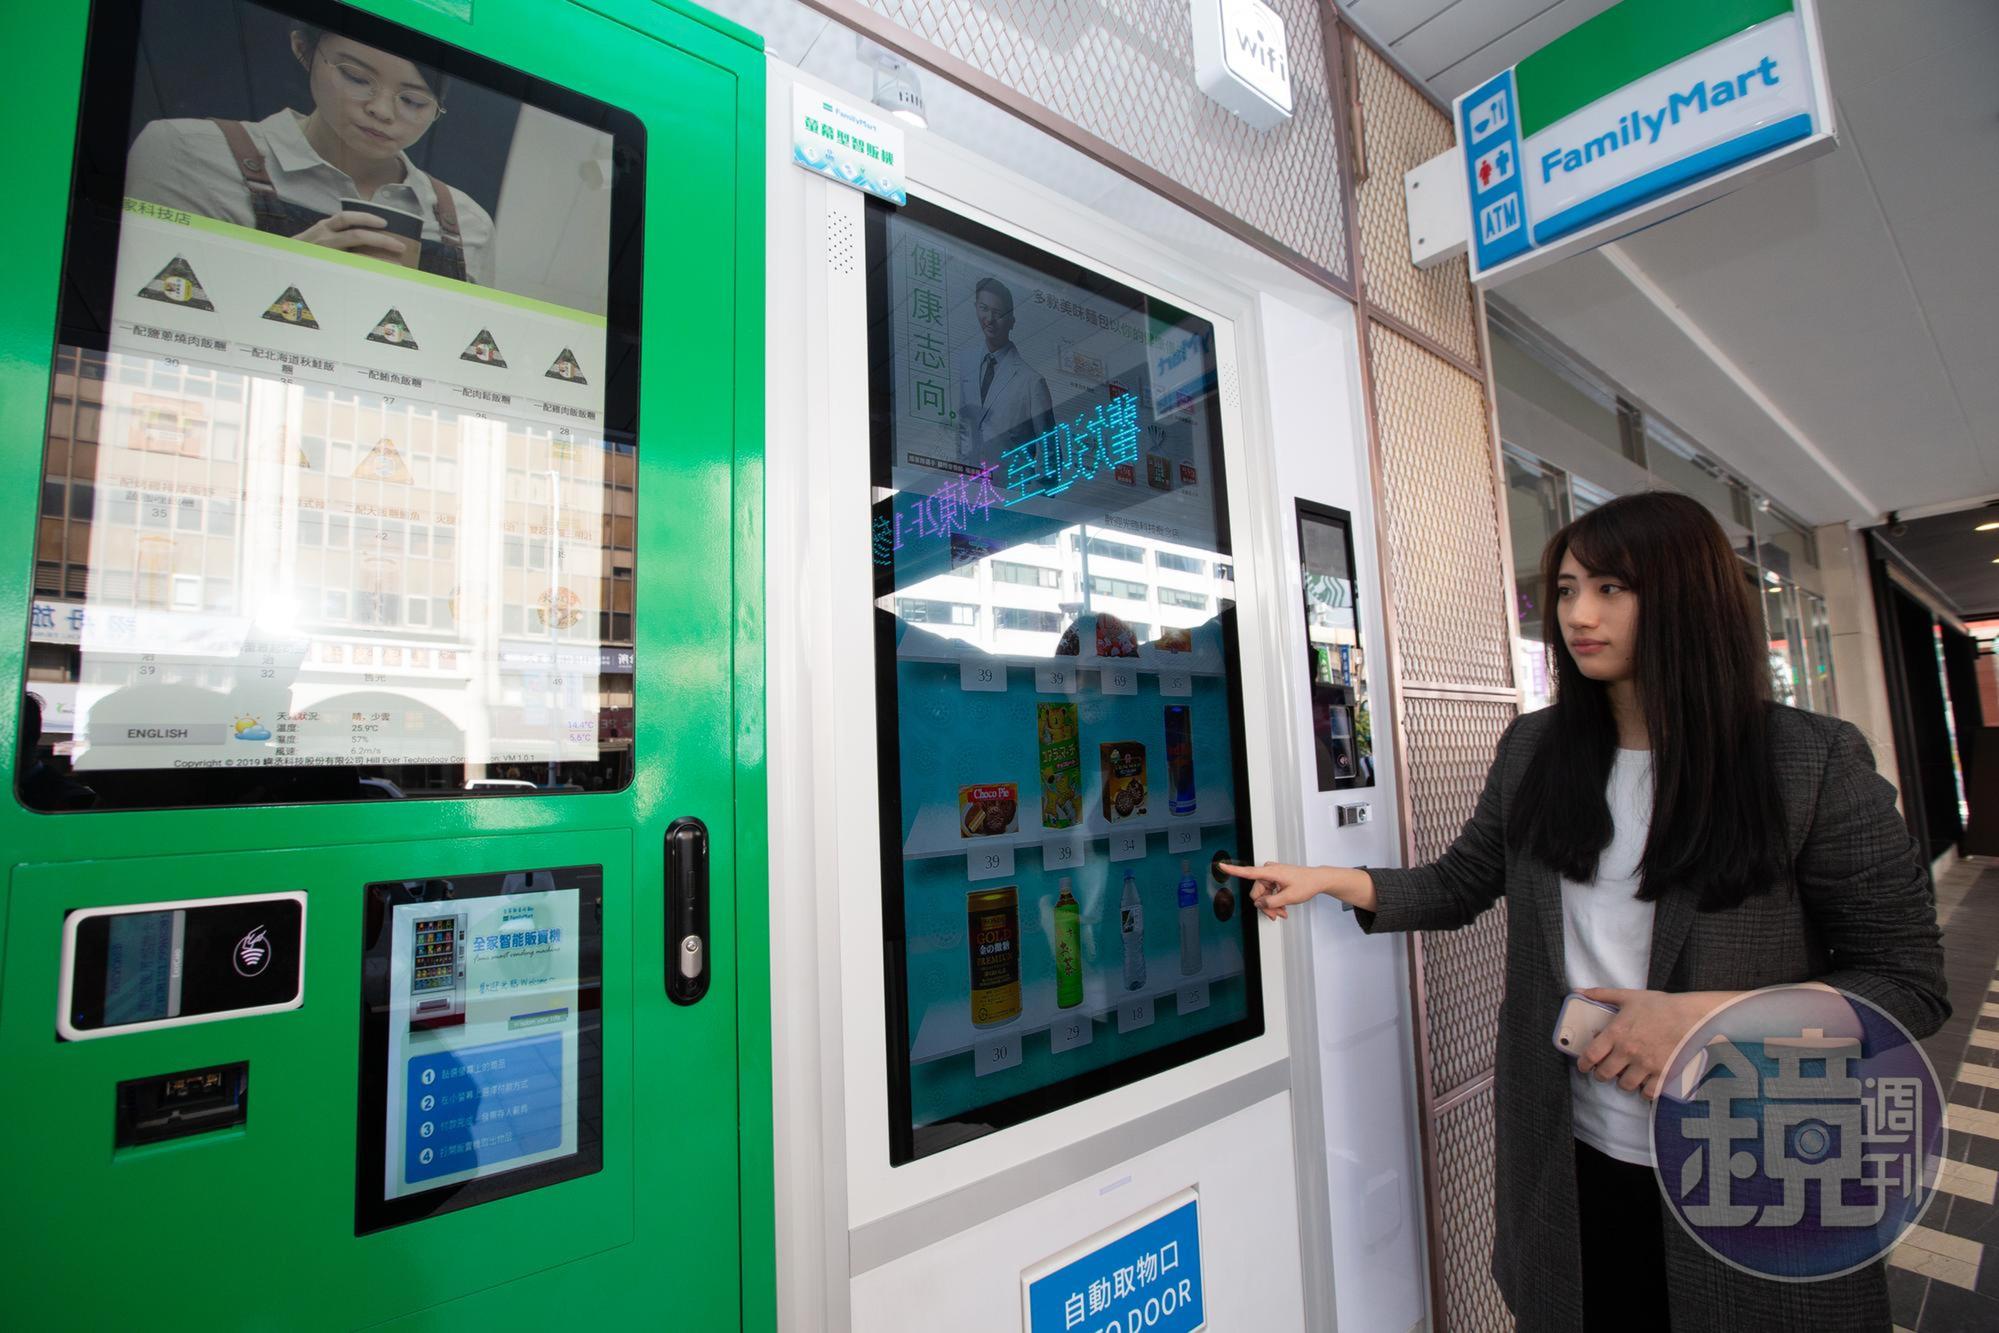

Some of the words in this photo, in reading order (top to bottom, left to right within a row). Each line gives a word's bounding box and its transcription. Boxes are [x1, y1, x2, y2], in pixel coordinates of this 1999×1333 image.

[1236, 28, 1286, 82] wifi
[1541, 56, 1780, 184] FamilyMart
[123, 198, 191, 225] 家科技店
[1485, 198, 1517, 240] ATM
[164, 357, 180, 368] 30
[559, 427, 570, 436] 28
[151, 507, 168, 518] 35
[139, 665, 156, 675] 39
[260, 668, 275, 679] 32
[977, 669, 993, 683] 39
[1050, 672, 1064, 685] 39
[1113, 675, 1127, 687] 69
[128, 728, 188, 739] ENGLISH
[174, 759, 222, 768] Copyright
[236, 758, 261, 767] 2019
[973, 787, 998, 800] Choco
[998, 787, 1010, 799] Pie
[1057, 846, 1072, 860] 39
[985, 855, 1000, 870] 39
[473, 928, 562, 952] 全家智能販賣機
[976, 928, 1012, 945] GOLD
[1066, 1026, 1080, 1040] 29
[992, 1046, 1008, 1062] 30
[1065, 1240, 1179, 1331] 自動取物口
[1128, 1278, 1192, 1333] DOOR
